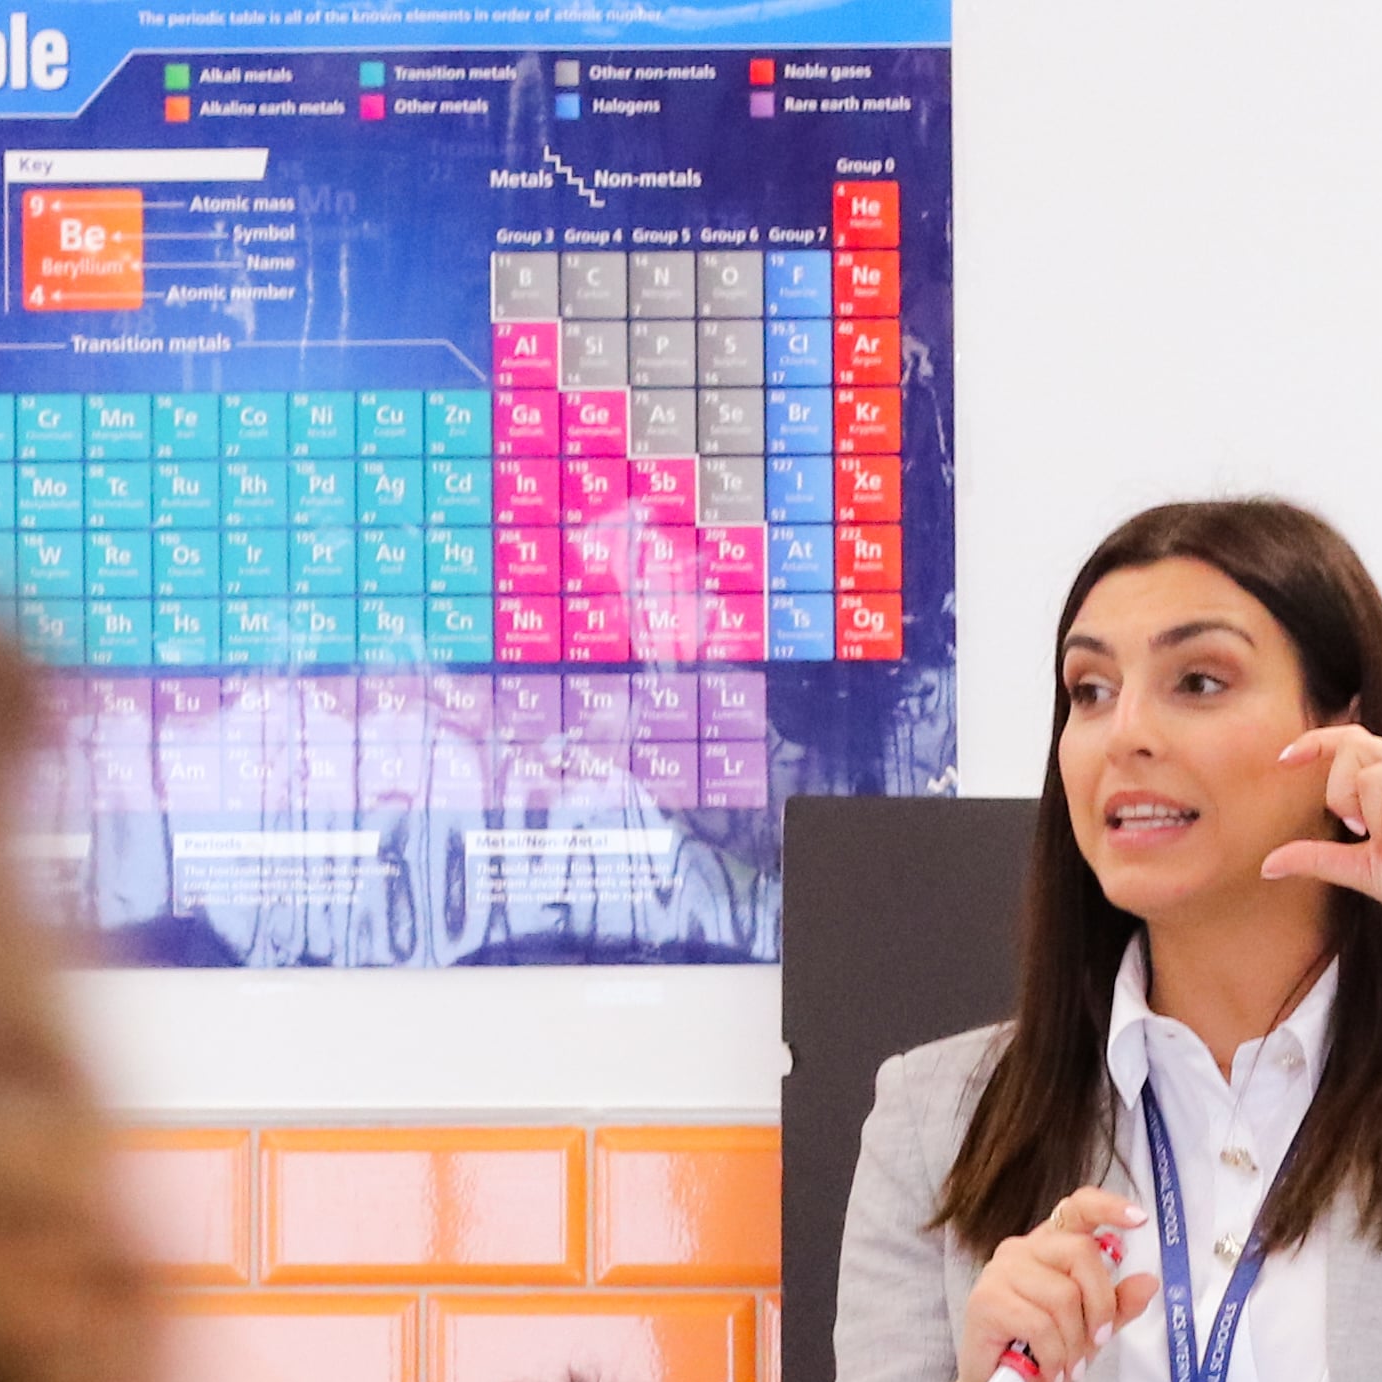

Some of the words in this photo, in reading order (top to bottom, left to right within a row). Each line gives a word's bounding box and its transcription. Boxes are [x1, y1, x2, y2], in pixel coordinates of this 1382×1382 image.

[138, 10, 165, 25] The
[168, 10, 225, 27] periodic
[230, 11, 265, 25] table
[270, 11, 280, 25] is
[285, 9, 301, 25] all
[305, 9, 320, 24] of
[325, 9, 348, 23] the
[352, 8, 401, 23] known
[406, 8, 469, 22] elements
[475, 8, 487, 22] in
[493, 7, 529, 22] order
[535, 7, 549, 22] of
[555, 7, 601, 22] atomic
[200, 68, 241, 84] Alkali
[244, 68, 293, 83] metals
[395, 67, 465, 82] Transition
[470, 66, 517, 81] metals
[589, 65, 630, 81] Other
[635, 65, 716, 80] non-metals
[784, 64, 827, 79] Noble
[831, 65, 871, 82] gases
[200, 101, 257, 117] Alkaline
[260, 101, 295, 116] earth
[298, 100, 345, 115] metals
[395, 99, 435, 115] Other
[439, 99, 489, 114] metals
[592, 98, 661, 116] Halogens
[784, 97, 817, 112] Rare
[821, 97, 857, 112] earth
[861, 97, 911, 112] metals
[19, 157, 53, 175] Key
[836, 158, 882, 176] Group
[886, 158, 895, 172] 0
[490, 170, 553, 188] Metals
[594, 169, 702, 188] Non-metals
[30, 196, 45, 217] 9
[189, 196, 249, 213] Atomic
[253, 198, 295, 212] mass
[852, 198, 880, 216] He
[60, 218, 106, 251] Be
[233, 225, 295, 244] Symbol
[497, 228, 542, 246] Group
[546, 228, 555, 243] 3
[565, 228, 609, 245] Group
[612, 228, 622, 242] 4
[632, 228, 677, 245] Group
[681, 228, 691, 243] 5
[700, 228, 747, 245] Group
[750, 228, 759, 242] 6
[769, 227, 815, 245] Group
[818, 227, 827, 241] 7
[42, 257, 123, 279] Beryllium
[247, 256, 295, 270] Name
[520, 268, 532, 286] B
[587, 268, 601, 287] C
[654, 268, 669, 286] N
[722, 267, 738, 285] O
[793, 267, 804, 284] F
[852, 267, 880, 285] Ne
[29, 285, 44, 305] 4
[167, 285, 227, 301] Atomic
[231, 285, 295, 301] number
[72, 333, 164, 352] Transition
[169, 333, 231, 352] metals
[514, 337, 538, 355] Al
[585, 336, 603, 355] Si
[657, 337, 669, 354] P
[725, 336, 736, 354] S
[789, 335, 808, 353] Cl
[855, 335, 880, 353] Ar
[38, 410, 60, 428] Cr
[100, 409, 135, 428] Mn
[174, 408, 198, 427] Fe
[240, 408, 267, 426] Co
[312, 407, 333, 425] Ni
[376, 406, 404, 425] Cu
[445, 405, 470, 425] Zn
[512, 405, 541, 424] Ga
[580, 405, 609, 424] Ge
[650, 405, 676, 424] As
[720, 404, 743, 423] Se
[788, 403, 810, 422] Br
[856, 403, 880, 422] Kr
[32, 478, 67, 496] Mo
[107, 478, 128, 496] Tc
[172, 477, 199, 496] Ru
[241, 475, 267, 494] Rh
[309, 474, 335, 494] Pd
[375, 476, 405, 499] Ag
[445, 474, 471, 493] Cd
[517, 475, 536, 493] In
[582, 473, 608, 493] Sn
[650, 472, 676, 492] Sb
[854, 472, 882, 490] Xe
[172, 546, 200, 564] Os
[247, 545, 262, 562] Ir
[376, 545, 405, 562] Au
[445, 543, 474, 566] Hg
[788, 541, 813, 559] At
[855, 540, 882, 558] Rn
[105, 614, 131, 633] Bh
[377, 613, 404, 635] Rg
[445, 612, 472, 631] Cn
[513, 610, 542, 630] Nh
[853, 608, 884, 632] Og
[652, 689, 678, 708] Yb
[721, 690, 745, 708] Lu
[1171, 1303, 1188, 1330] ACS
[1209, 1302, 1239, 1374] SCHOOLS
